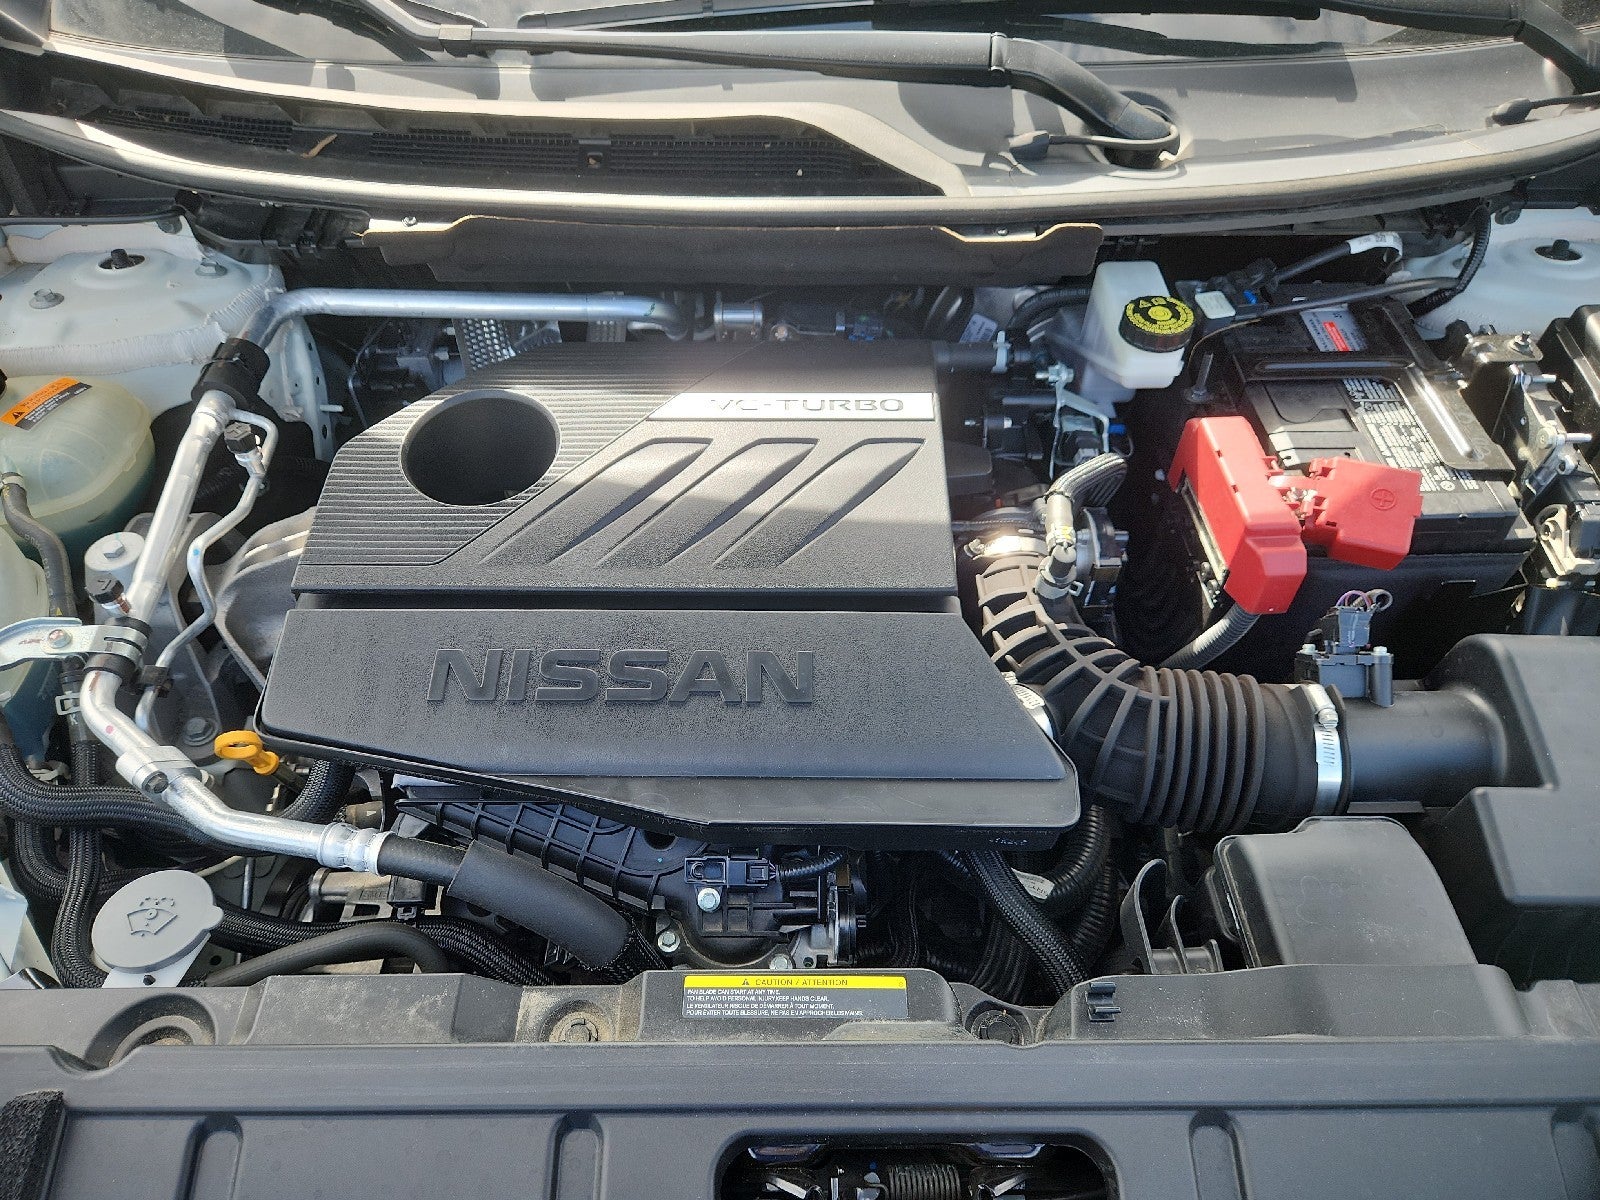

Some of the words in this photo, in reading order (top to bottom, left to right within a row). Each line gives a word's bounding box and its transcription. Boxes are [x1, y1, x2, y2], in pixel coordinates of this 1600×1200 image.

[710, 399, 904, 411] VC-TURBO
[426, 649, 813, 703] NISSAN
[755, 978, 793, 986] CAUTION
[802, 978, 848, 986] ATTENTION
